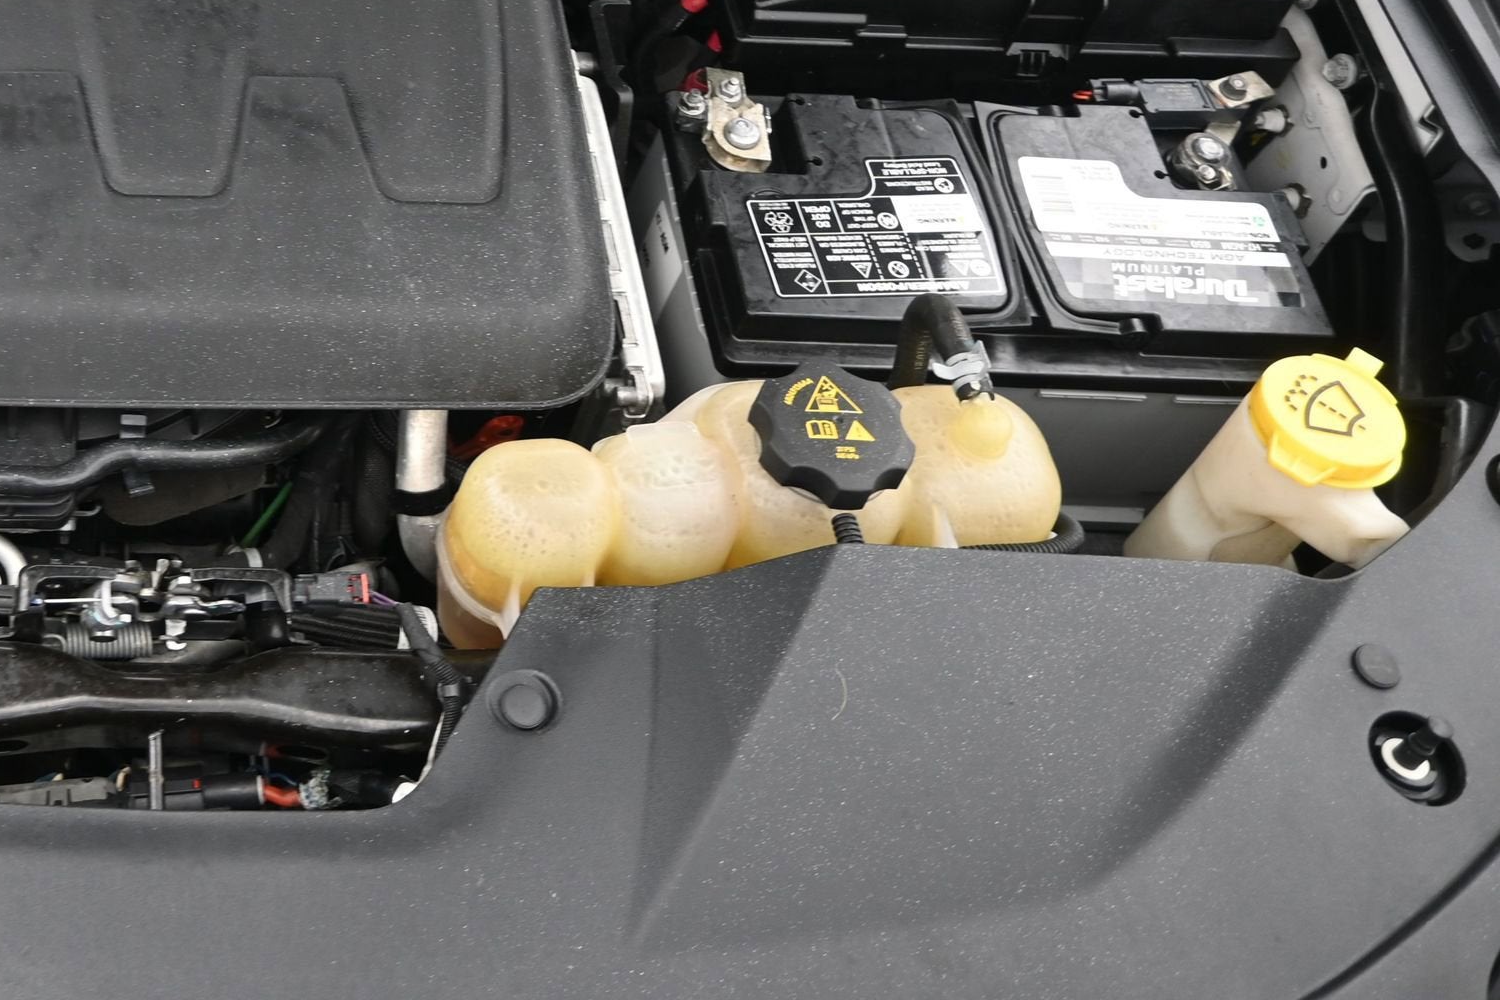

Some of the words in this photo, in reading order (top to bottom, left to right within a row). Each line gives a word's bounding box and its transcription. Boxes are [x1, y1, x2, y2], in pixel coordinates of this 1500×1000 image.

[1103, 248, 1205, 260] TECHNOLOGY
[1111, 262, 1205, 276] PLATINUM
[1112, 274, 1258, 302] Duralast
